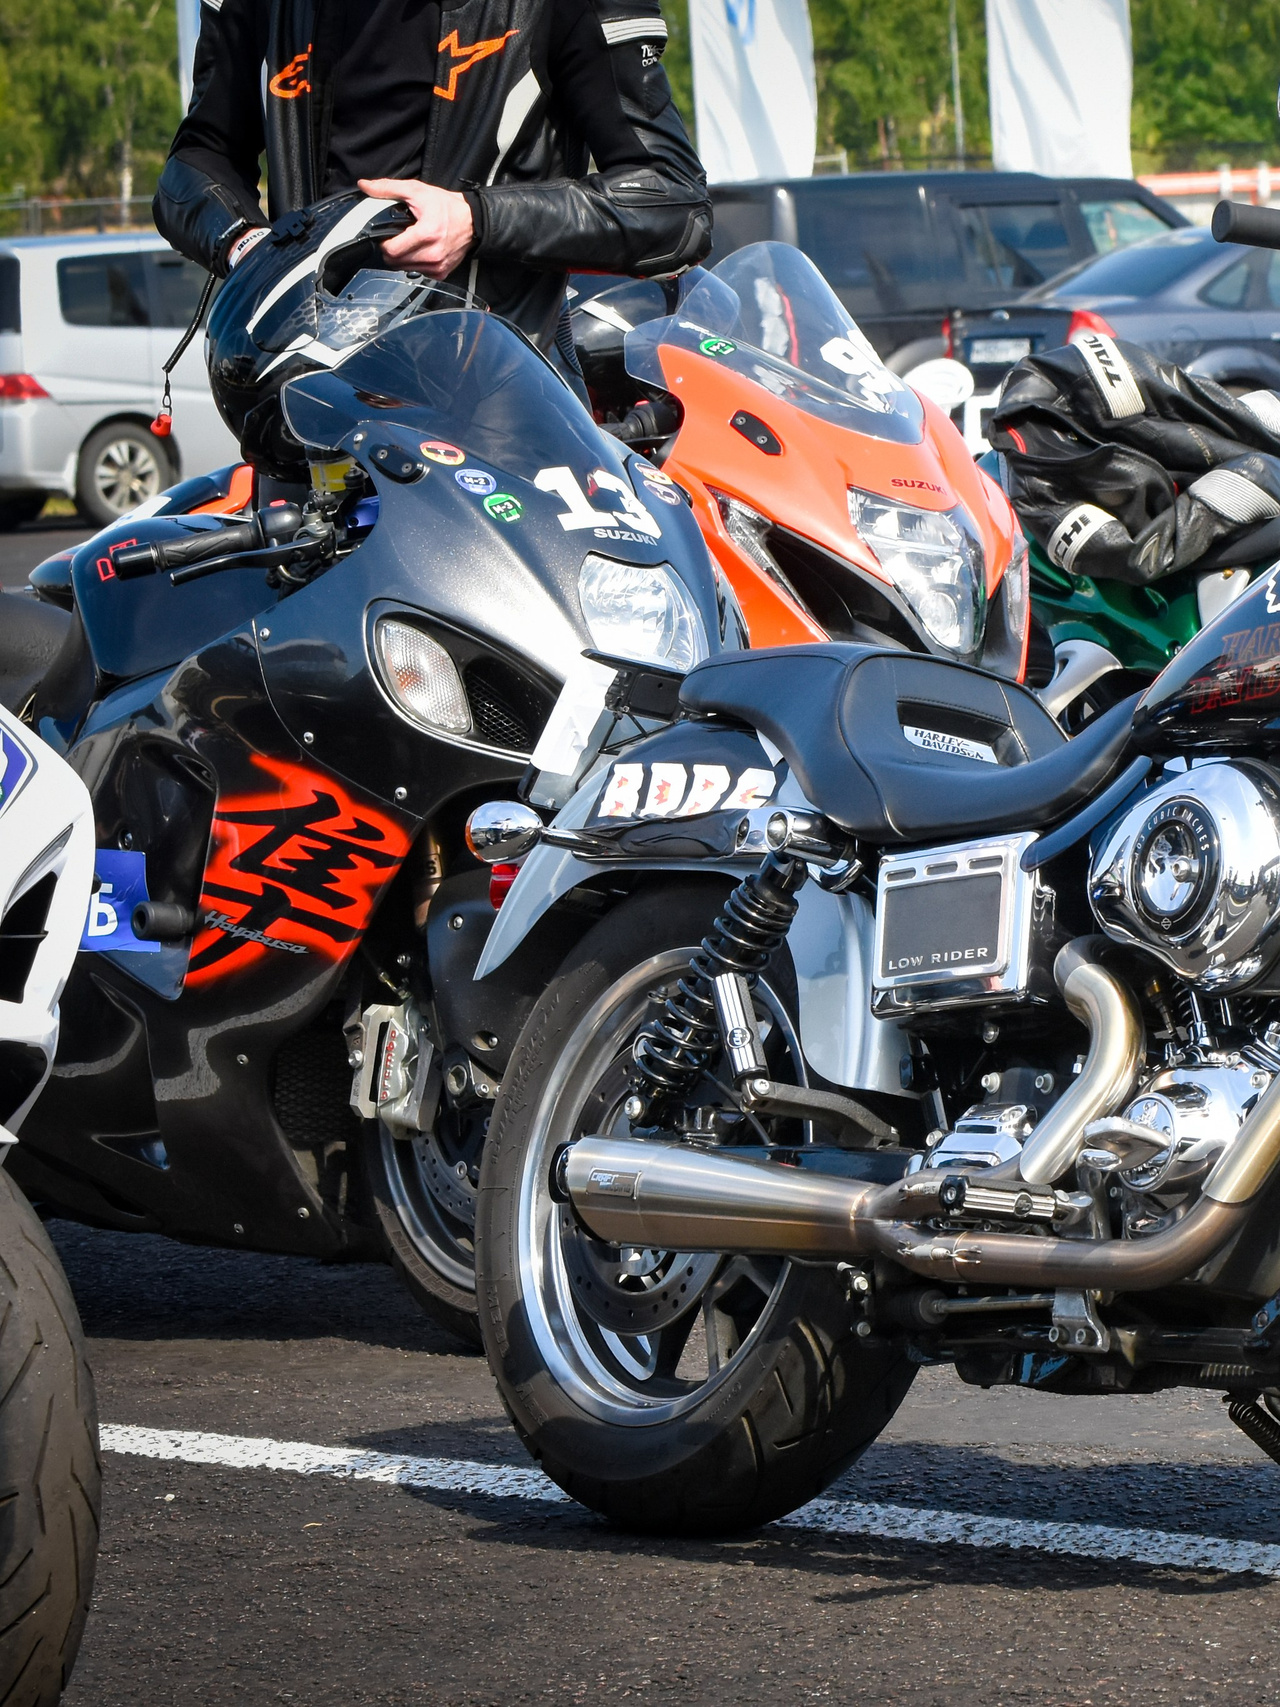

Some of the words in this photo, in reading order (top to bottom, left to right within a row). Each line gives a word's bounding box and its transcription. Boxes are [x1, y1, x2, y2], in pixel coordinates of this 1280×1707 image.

[890, 478, 948, 496] SUZUKI
[533, 466, 662, 540] 13
[593, 528, 658, 547] SUZUKI
[913, 728, 970, 748] HARLEY-
[921, 738, 994, 761] DAVIDSON
[1147, 805, 1179, 832] CUBIC
[1180, 807, 1211, 852] INCHES
[203, 909, 310, 955] Hayabusa
[887, 954, 924, 971] LOW
[930, 946, 989, 965] RIDER
